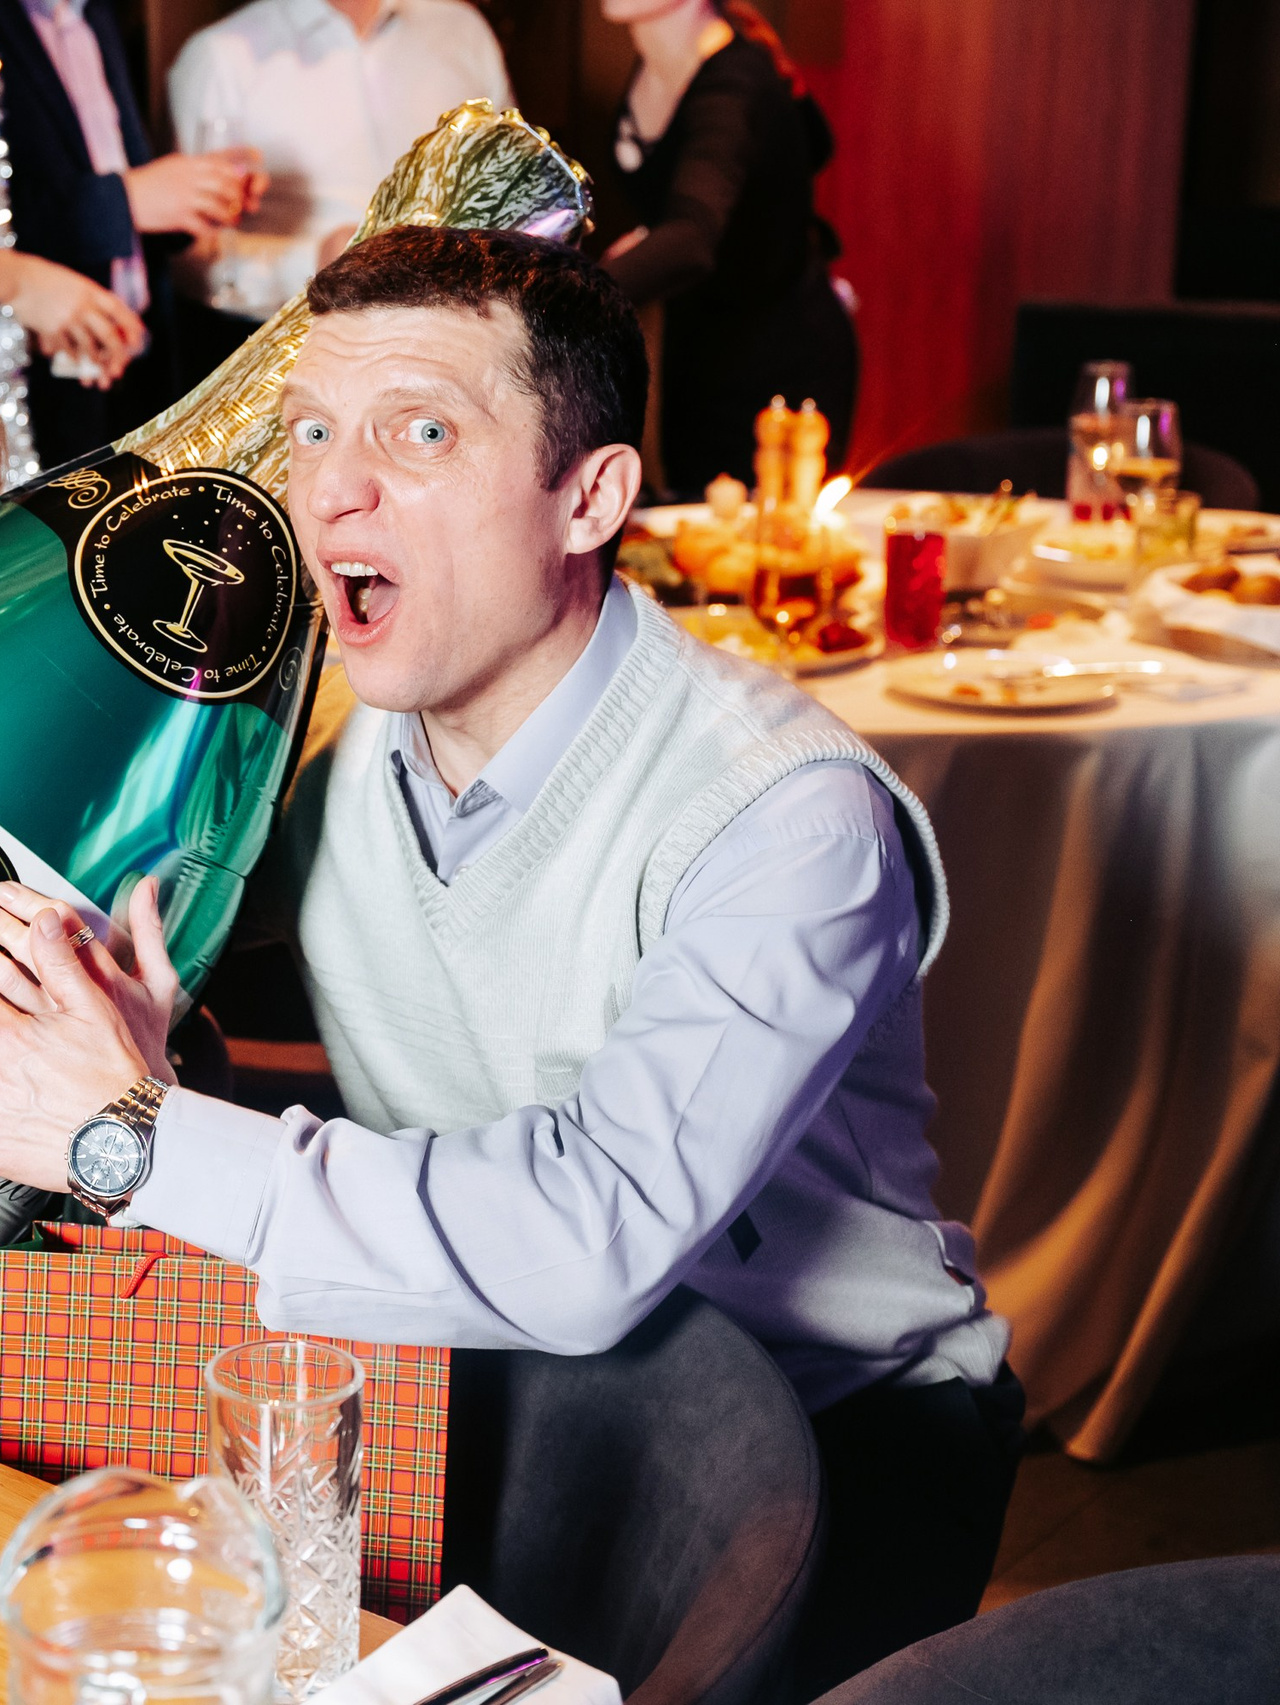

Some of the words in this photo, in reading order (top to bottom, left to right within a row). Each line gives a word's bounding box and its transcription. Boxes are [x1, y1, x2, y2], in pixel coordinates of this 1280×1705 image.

[105, 486, 192, 532] Celebrate
[94, 534, 111, 550] to
[213, 484, 257, 520] Time
[259, 520, 273, 540] to
[266, 545, 289, 640] Celebrate
[89, 553, 109, 599] Time
[113, 613, 203, 682] Celebrate
[224, 653, 262, 678] Time
[203, 669, 221, 683] to
